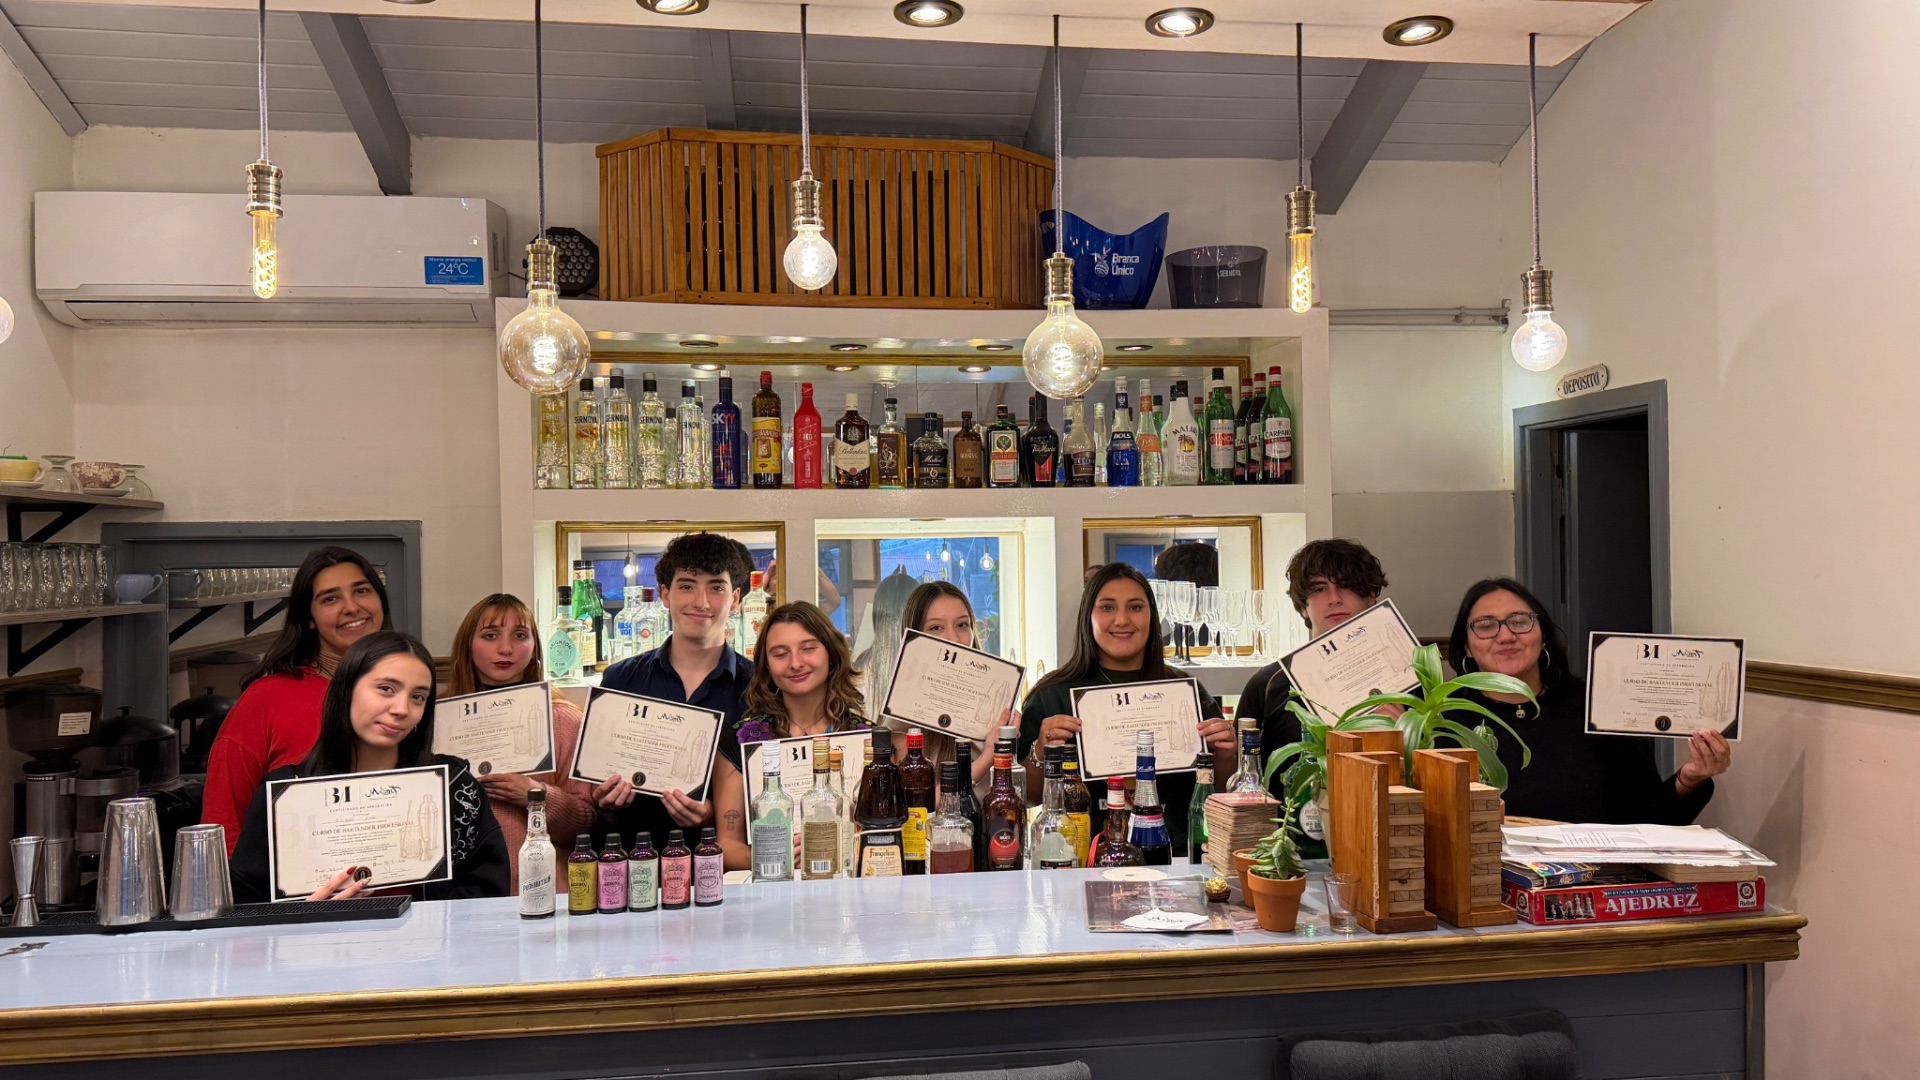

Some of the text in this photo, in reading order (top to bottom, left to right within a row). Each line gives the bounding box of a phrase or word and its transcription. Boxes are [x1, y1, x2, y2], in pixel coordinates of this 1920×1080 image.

[1112, 252, 1140, 263] Branca
[438, 262, 469, 275] 24°C
[1562, 371, 1600, 395] DEPOSITO
[575, 416, 598, 424] SERNOVA
[605, 414, 629, 422] SERNOVA
[640, 416, 663, 424] SERNOVA
[711, 412, 736, 425] SKYY
[312, 829, 333, 837] CURSO
[342, 824, 376, 834] BARTENDER
[377, 820, 414, 830] PROFESIONAL
[869, 847, 895, 859] Frangelico
[1604, 893, 1700, 916] AJEDREZ
